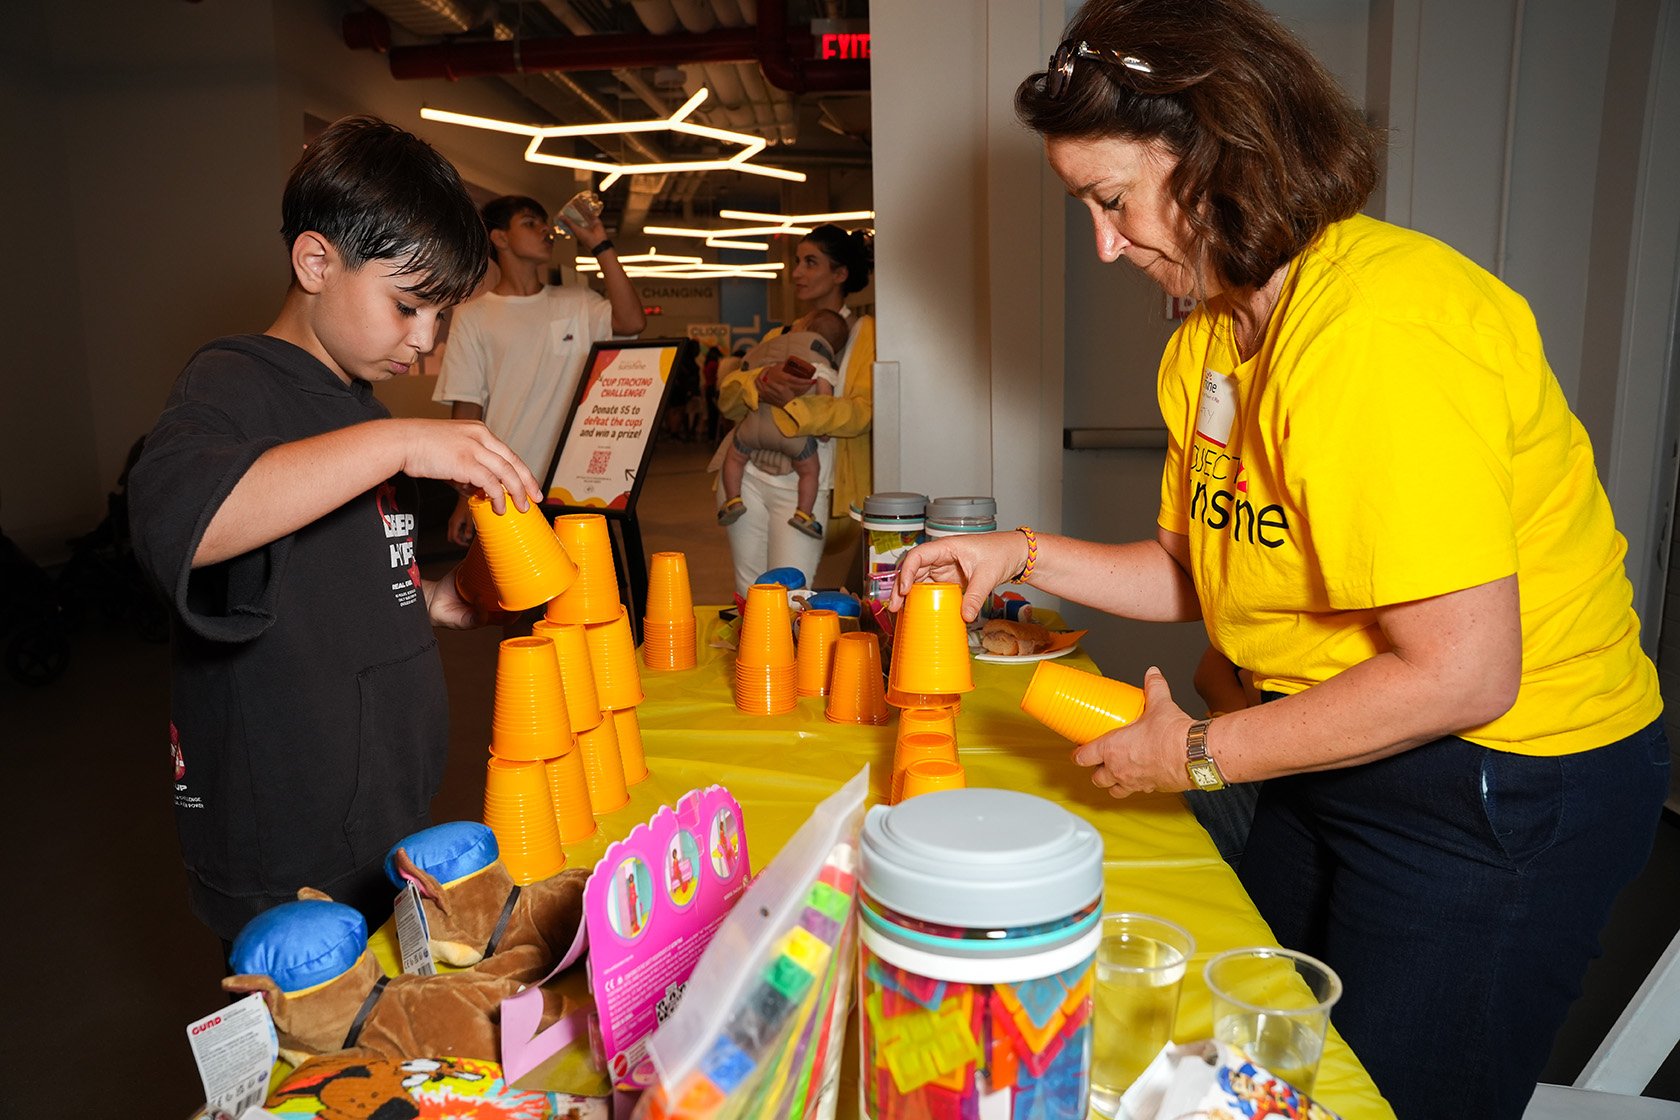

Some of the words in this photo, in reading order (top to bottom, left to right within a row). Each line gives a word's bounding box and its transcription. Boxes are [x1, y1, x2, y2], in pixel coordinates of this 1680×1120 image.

[642, 287, 713, 298] CHANGING
[601, 378, 617, 387] CUP
[617, 377, 653, 387] STACKING
[601, 388, 647, 398] CHALLENGE!
[591, 404, 619, 414] Donate
[620, 405, 631, 415] $5
[631, 405, 641, 415] to
[583, 416, 610, 426] defeat
[610, 416, 624, 426] the
[625, 418, 644, 429] cups
[579, 427, 595, 438] and
[595, 429, 610, 438] win
[616, 428, 643, 441] prize!
